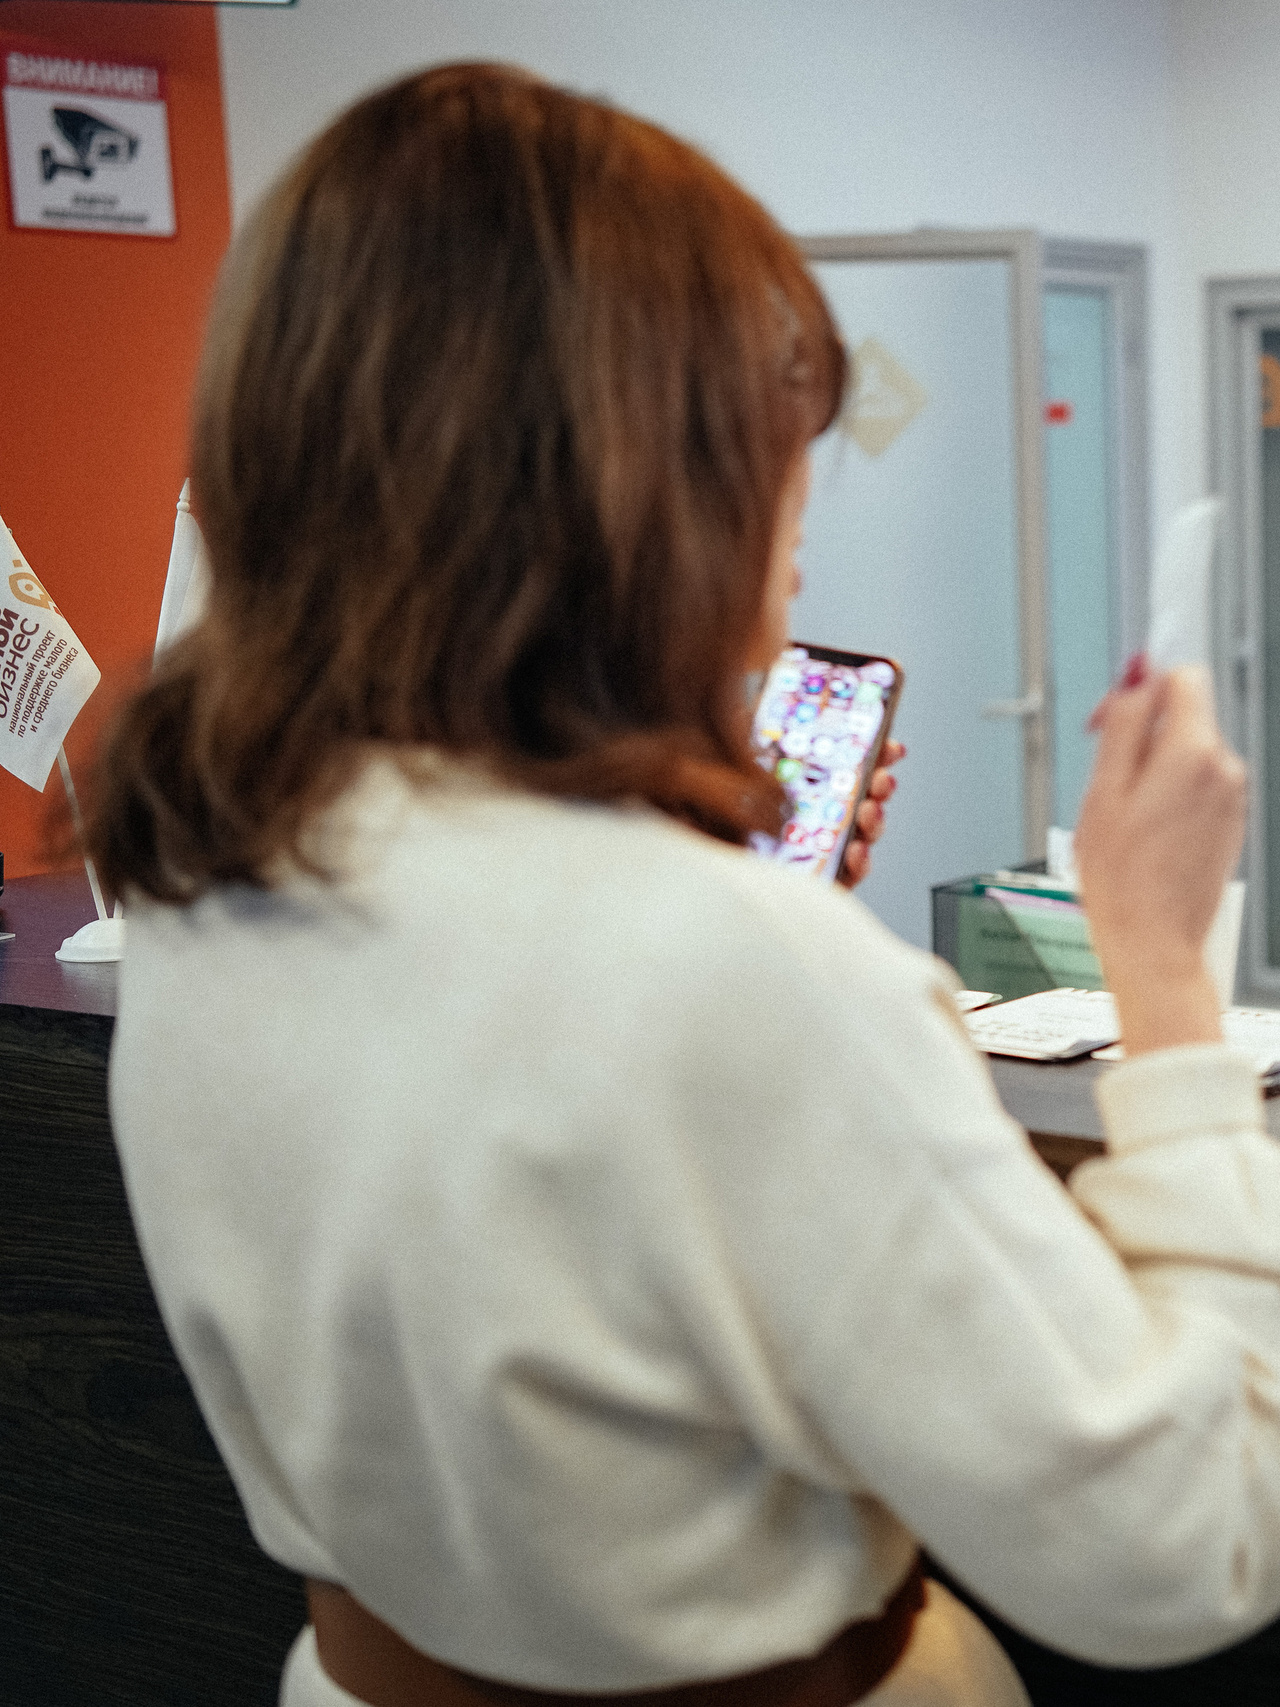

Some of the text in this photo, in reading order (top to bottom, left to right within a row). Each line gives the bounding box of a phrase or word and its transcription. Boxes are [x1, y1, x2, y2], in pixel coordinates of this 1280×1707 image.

[9, 630, 56, 734] национальный проект
[17, 638, 68, 739] по поддержке малого
[30, 647, 79, 733] и среднего бизнеса
